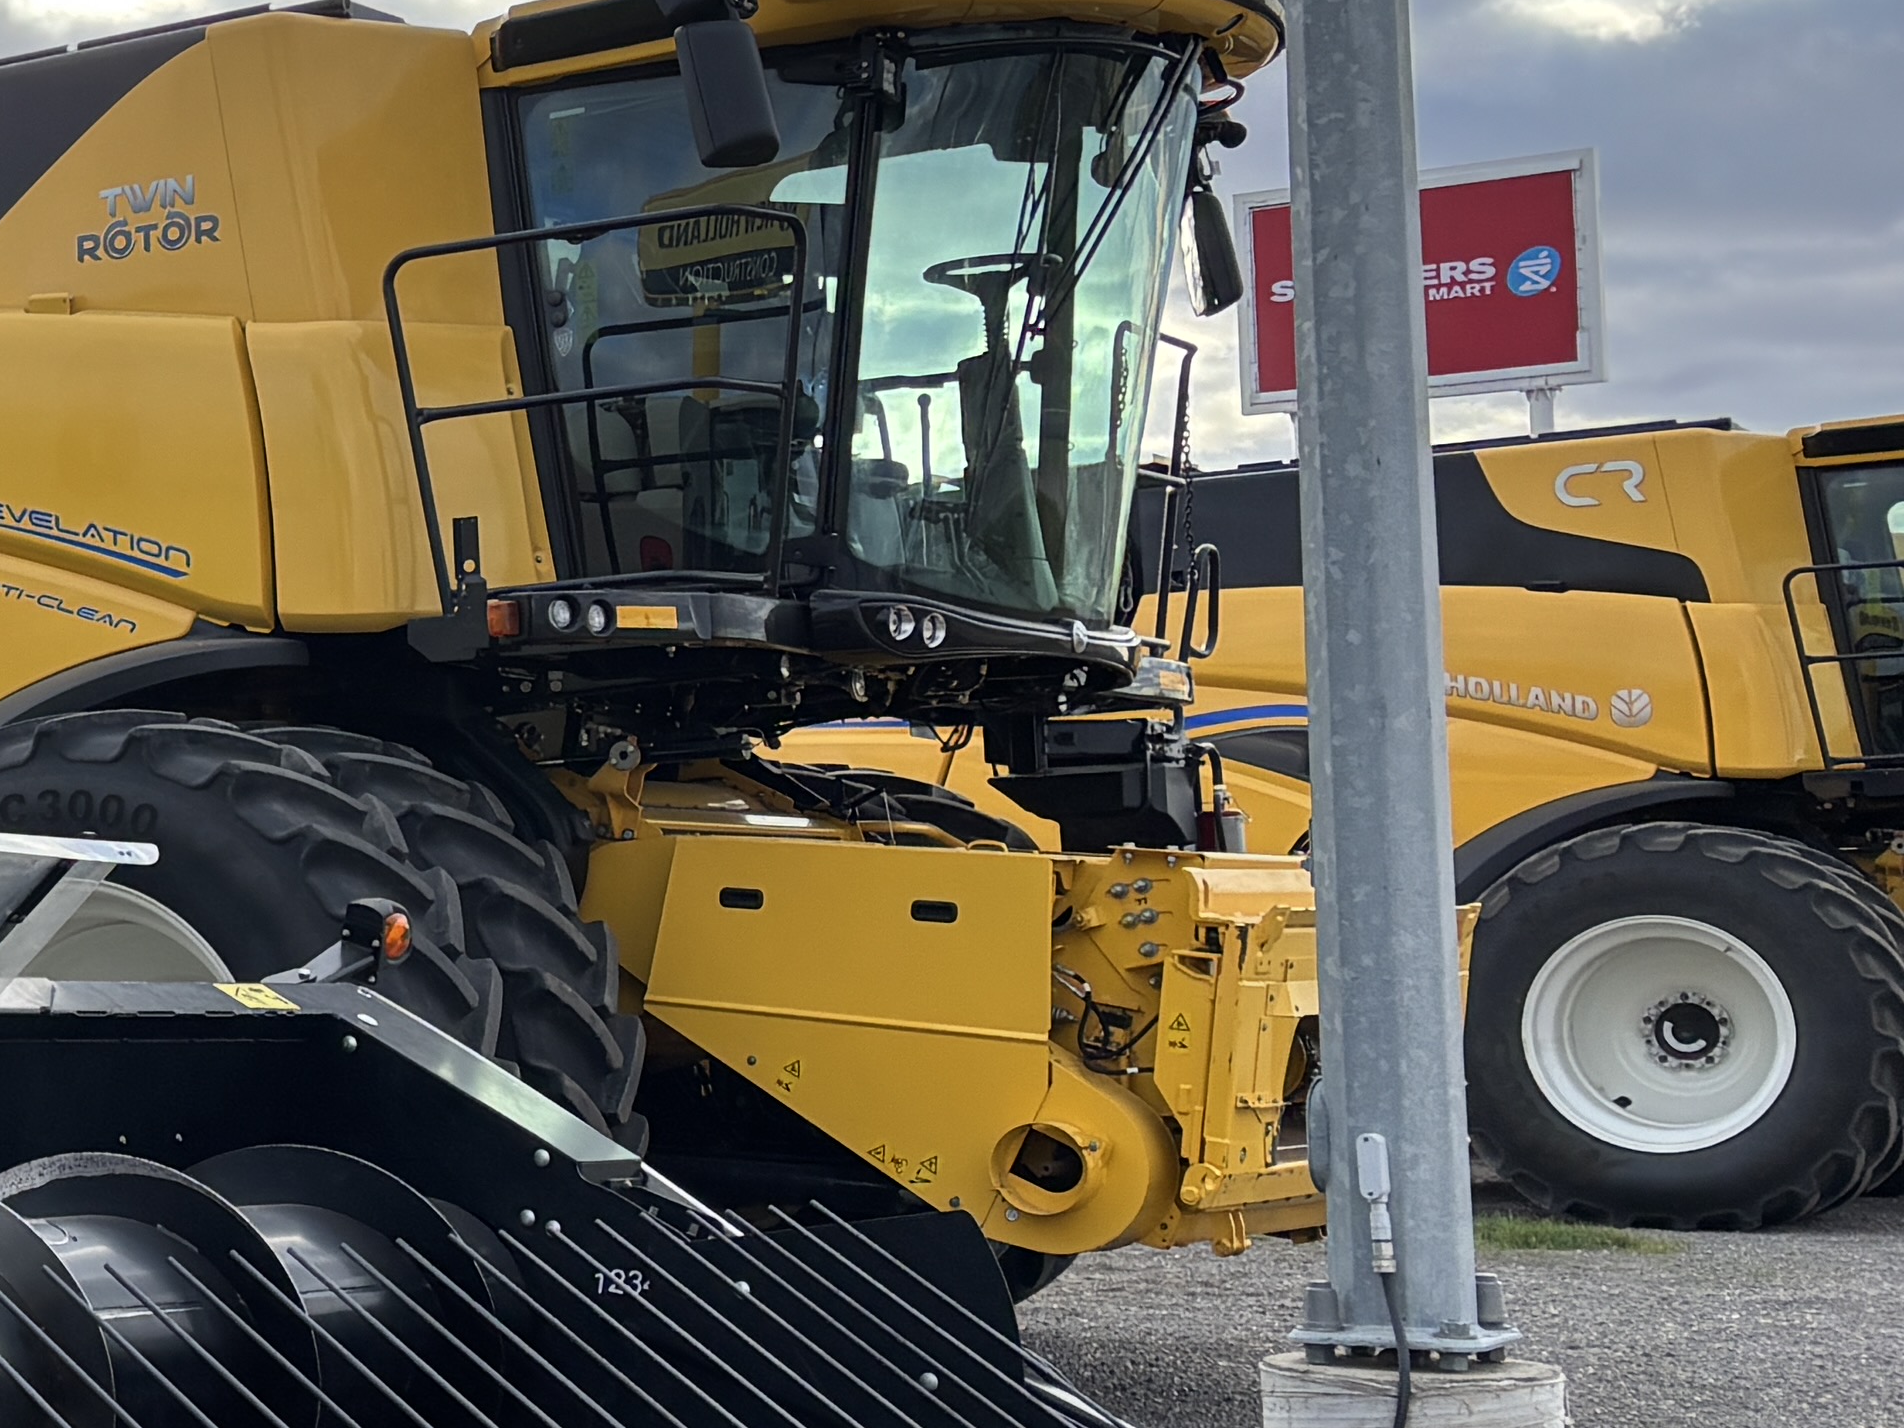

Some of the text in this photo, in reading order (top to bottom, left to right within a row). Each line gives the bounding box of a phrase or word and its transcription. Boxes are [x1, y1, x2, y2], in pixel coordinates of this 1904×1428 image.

[99, 175, 195, 218] TWIN
[76, 209, 221, 263] ROTOR
[1428, 281, 1496, 301] MART
[1553, 460, 1647, 508] CR
[1444, 673, 1598, 721] HOLLAND
